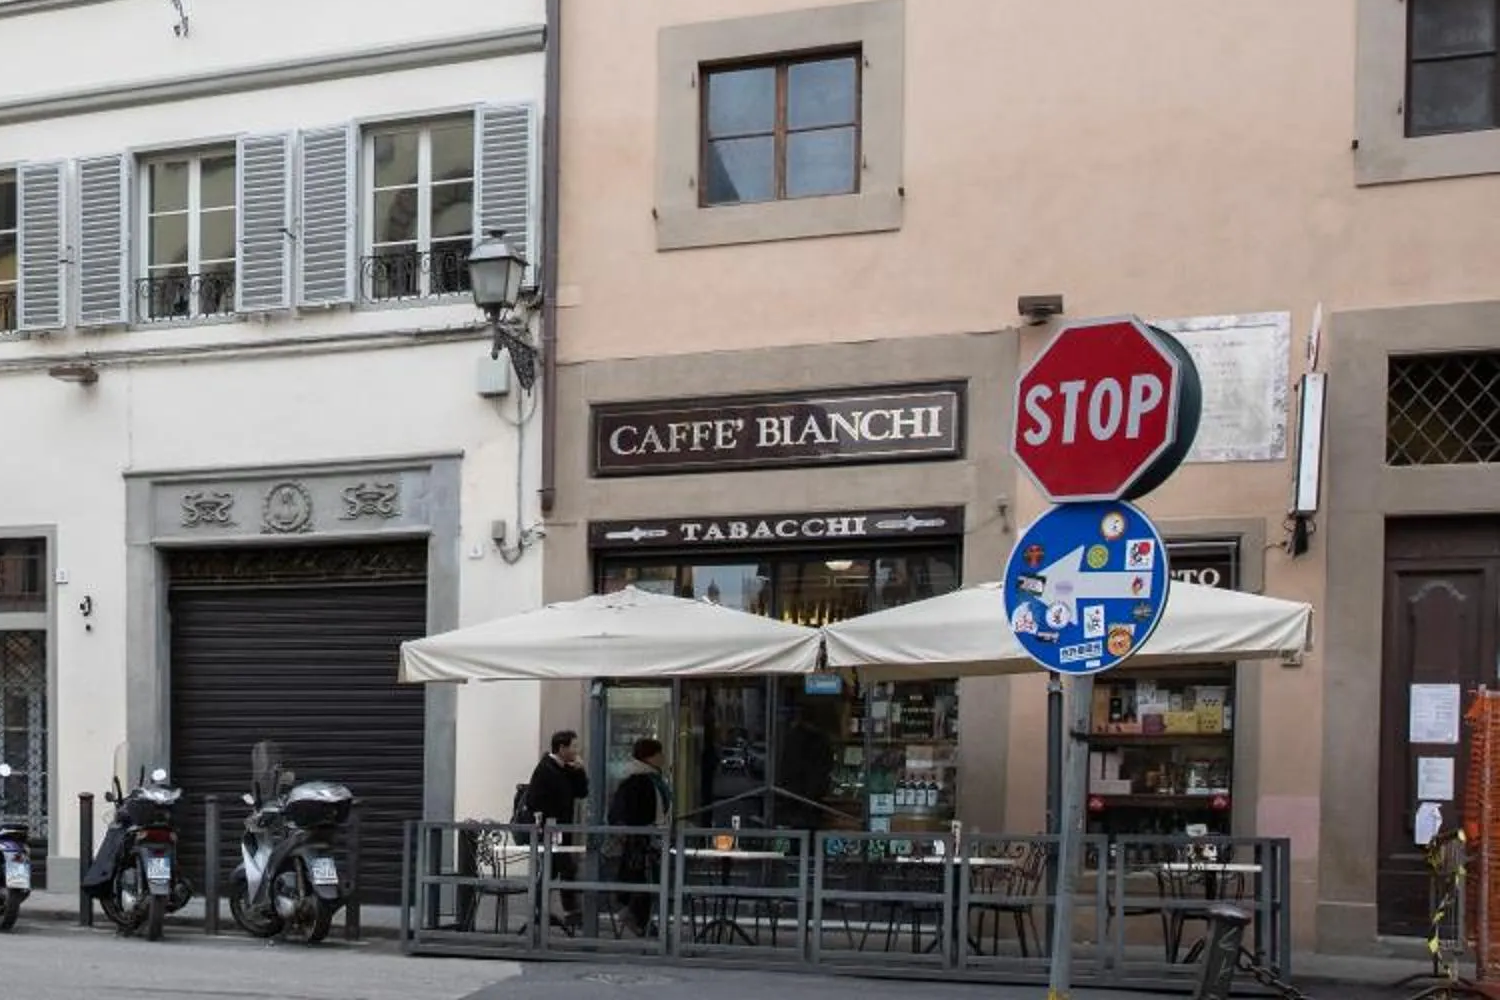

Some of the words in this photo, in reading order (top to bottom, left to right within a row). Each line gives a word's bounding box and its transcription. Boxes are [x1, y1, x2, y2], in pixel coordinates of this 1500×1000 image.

[1024, 374, 1162, 446] STOP
[610, 419, 745, 456] CAFFE'
[756, 406, 942, 447] BIANCHI
[680, 517, 867, 542] TABACCHI
[1170, 568, 1220, 587] TO
